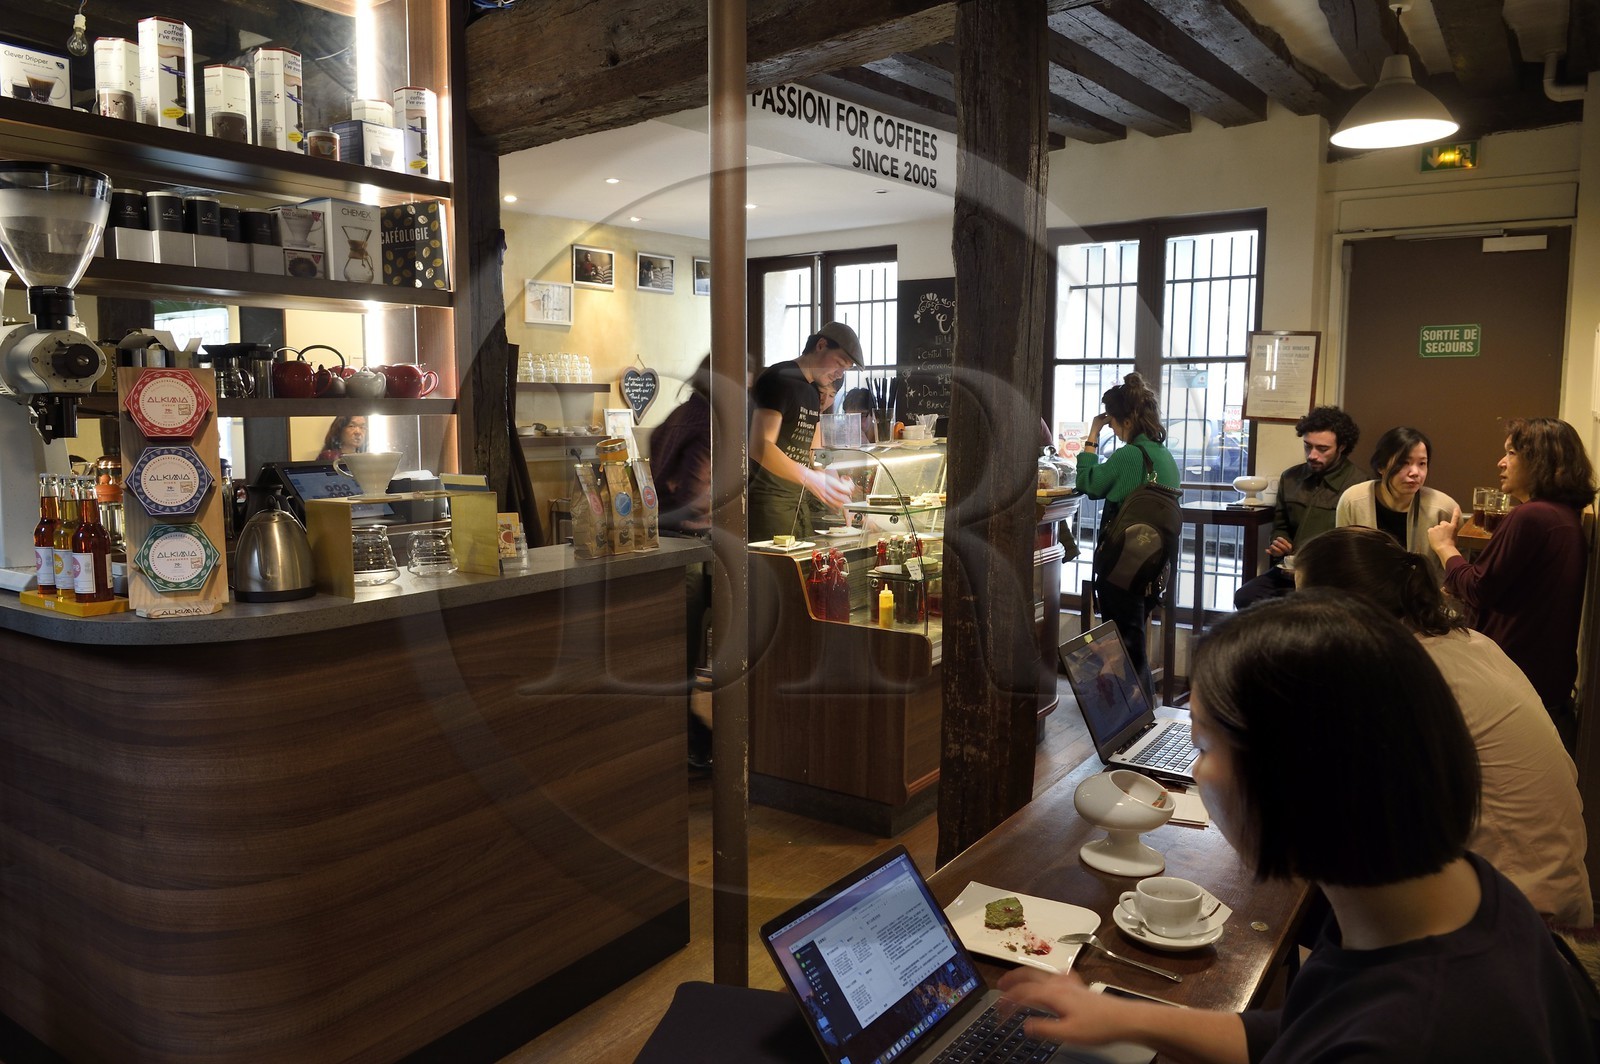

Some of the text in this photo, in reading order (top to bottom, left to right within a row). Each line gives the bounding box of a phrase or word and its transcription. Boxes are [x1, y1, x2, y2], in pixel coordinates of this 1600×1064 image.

[4, 50, 49, 65] Clever Dripper
[752, 84, 938, 162] PASSION FOR COFFEES
[852, 145, 938, 189] SINCE 2005
[341, 207, 372, 219] CHEMEX
[380, 226, 430, 245] CAFÉOLOGIE
[1422, 328, 1477, 341] SORTIE DE
[1425, 341, 1474, 353] SECOURS
